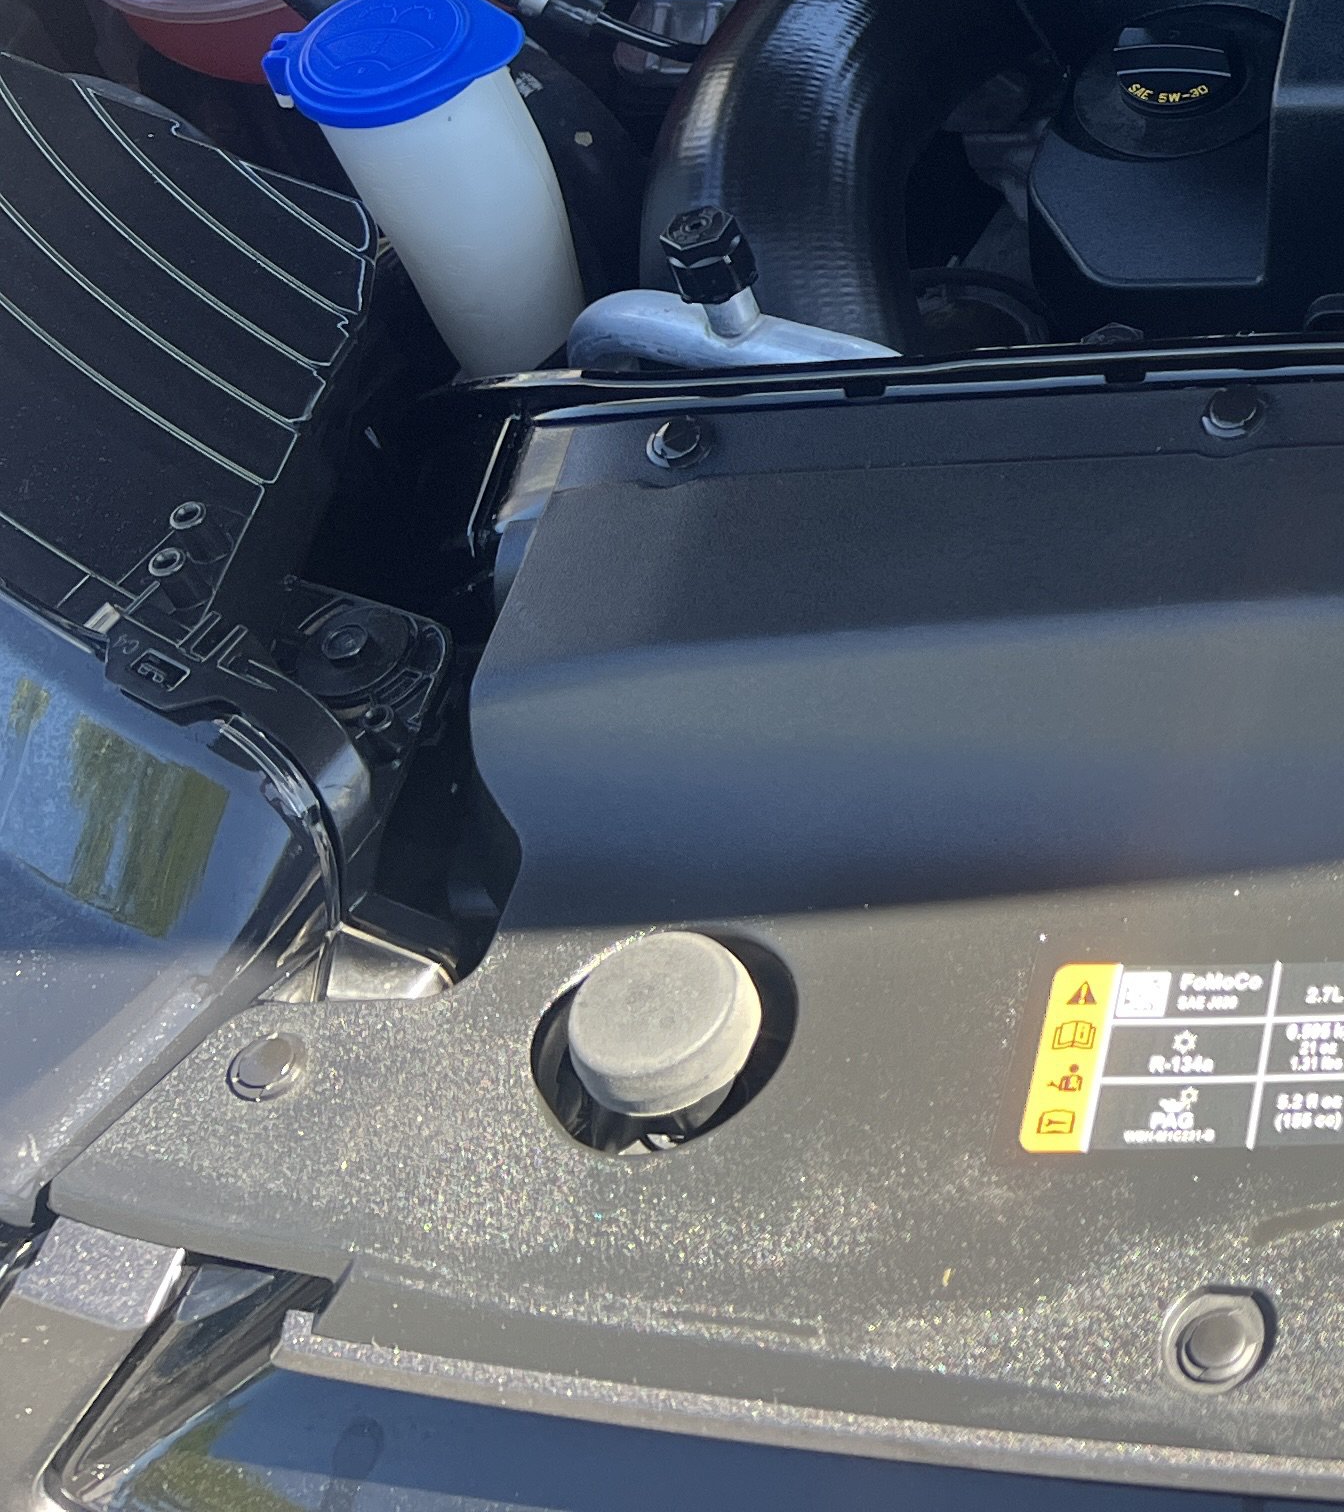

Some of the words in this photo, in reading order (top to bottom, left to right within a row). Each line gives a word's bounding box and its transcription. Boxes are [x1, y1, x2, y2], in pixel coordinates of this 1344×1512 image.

[1127, 83, 1154, 101] SAE
[1157, 84, 1209, 104] 5W-30
[1180, 971, 1264, 992] FoMoCo
[1305, 985, 1344, 1004] 2.7L
[1148, 1054, 1215, 1074] R-134a
[1149, 1111, 1195, 1130] PAG
